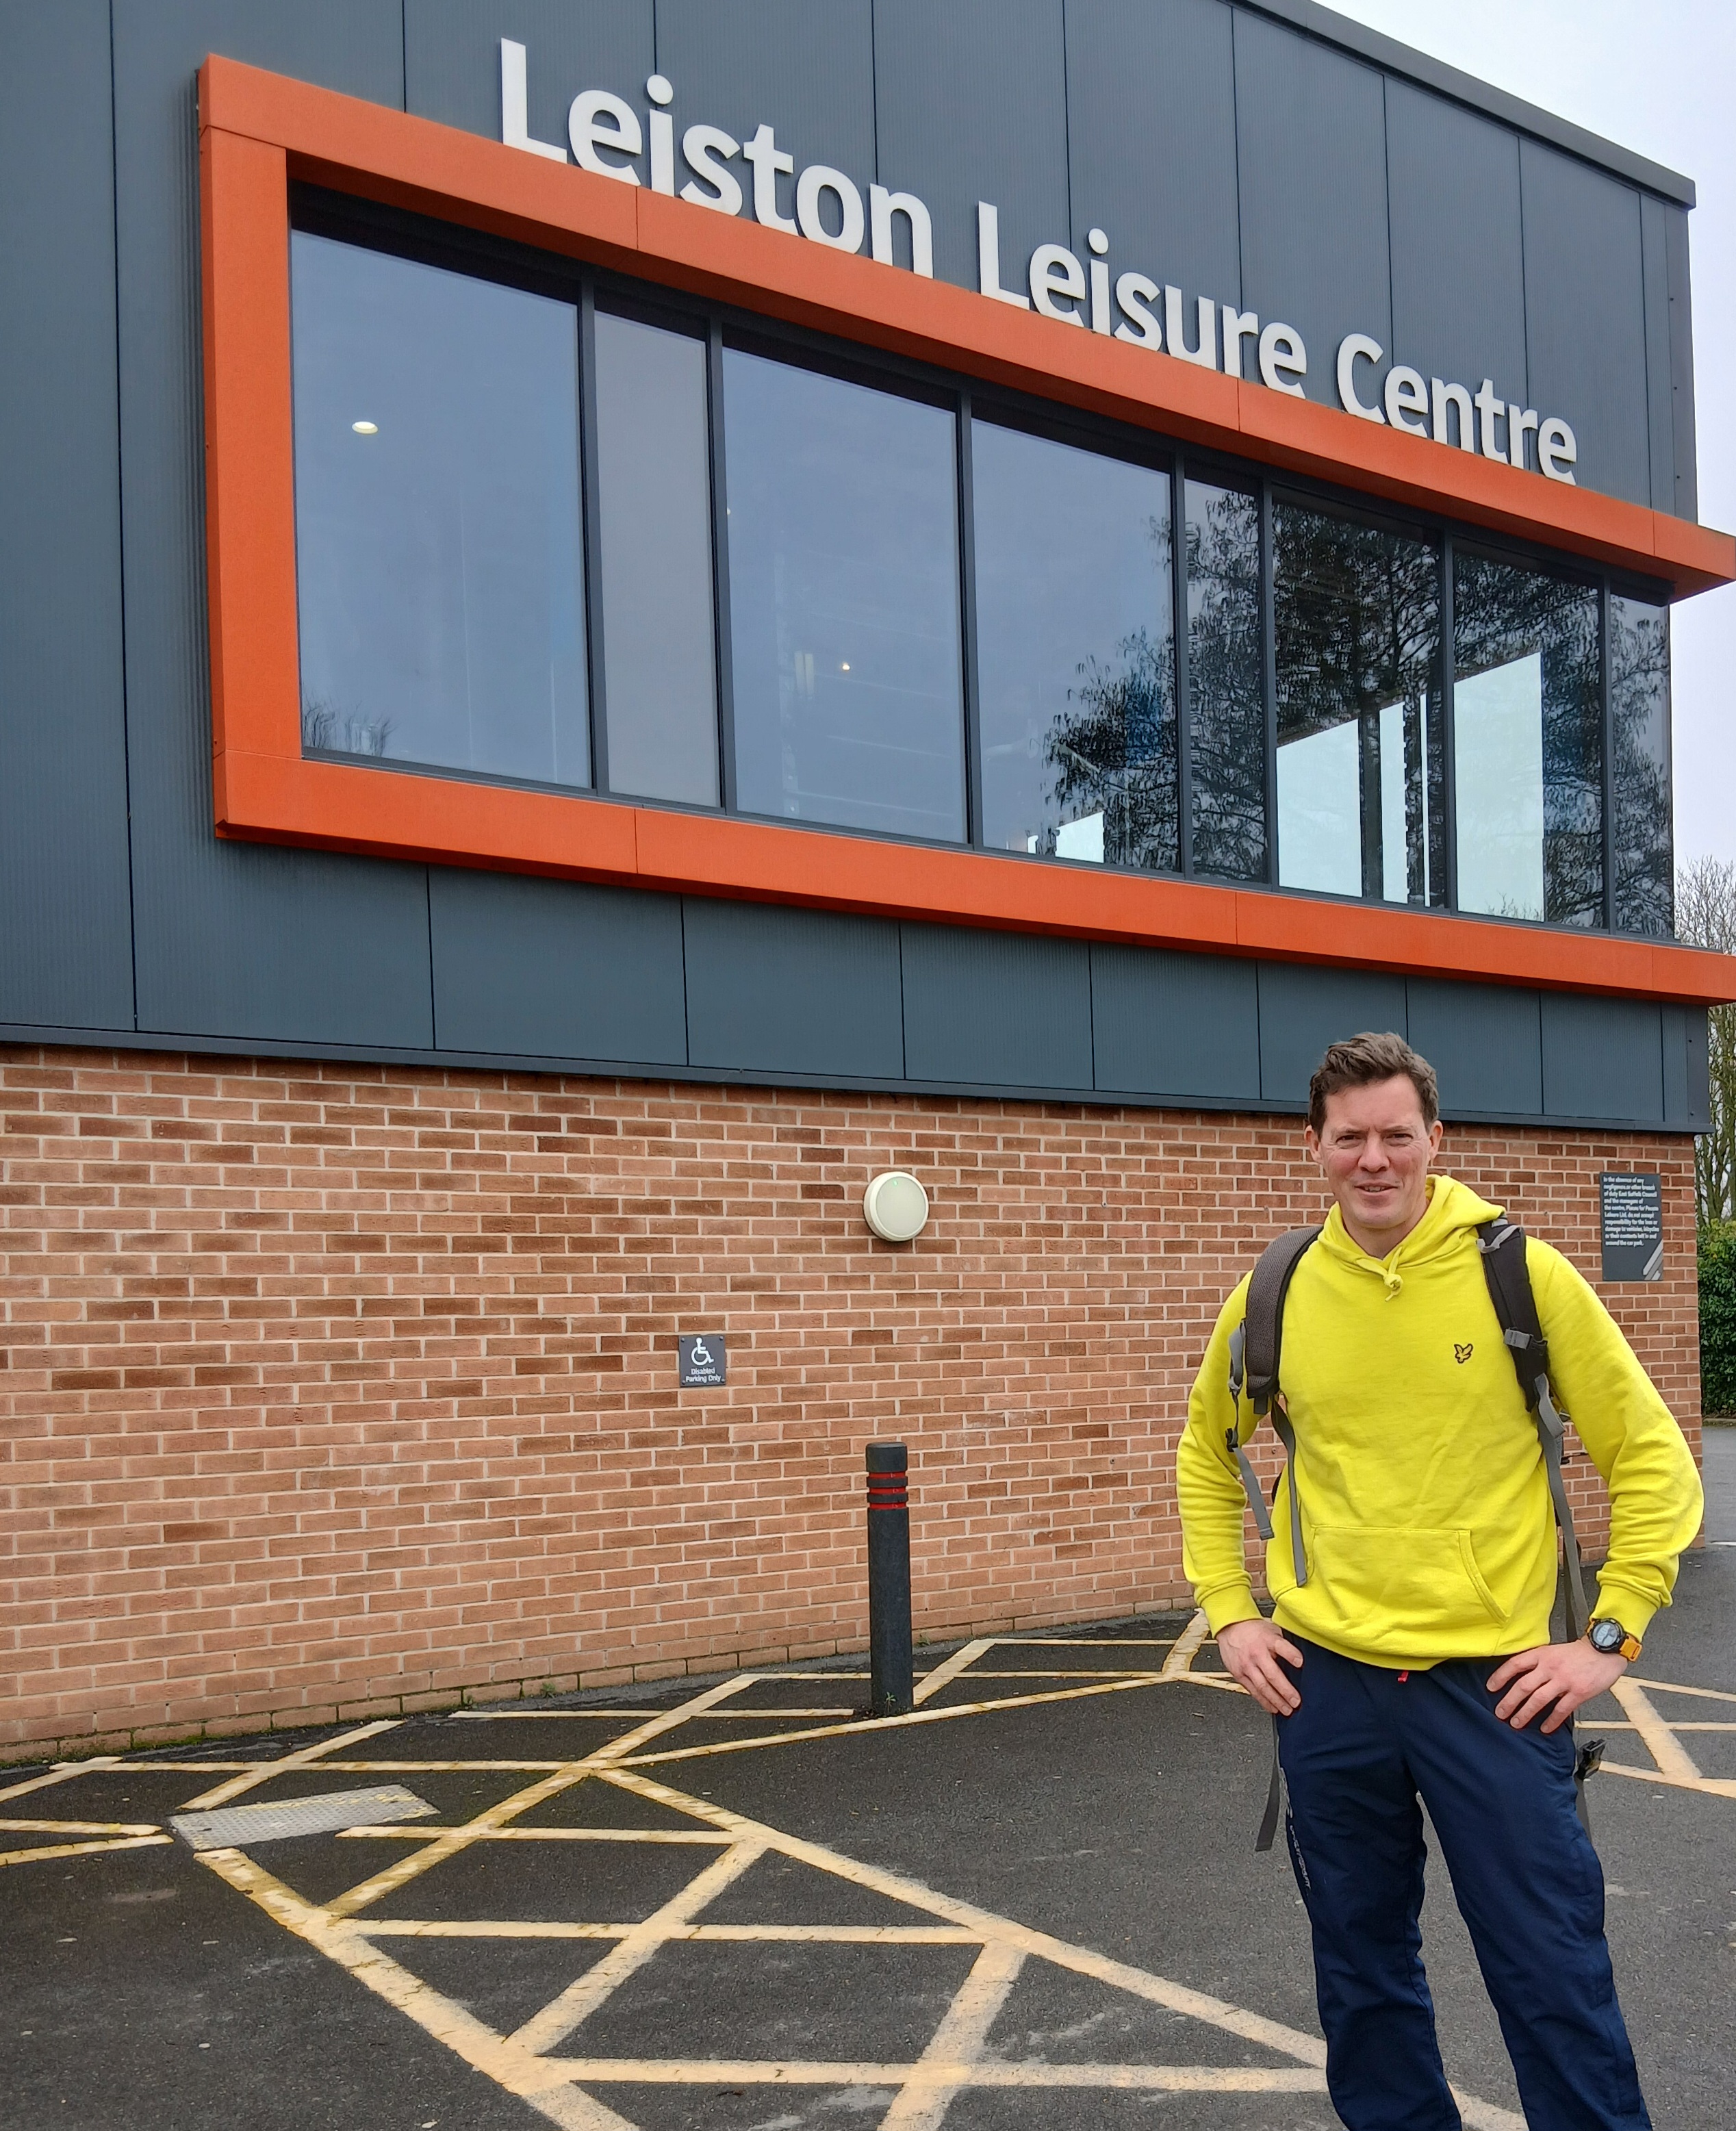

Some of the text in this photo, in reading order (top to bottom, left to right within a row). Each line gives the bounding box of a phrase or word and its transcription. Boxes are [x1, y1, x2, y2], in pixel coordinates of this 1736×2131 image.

[501, 37, 1577, 486] Leiston Leisure Centre
[691, 1366, 716, 1375] Disabled
[685, 1374, 722, 1383] Parking Only
